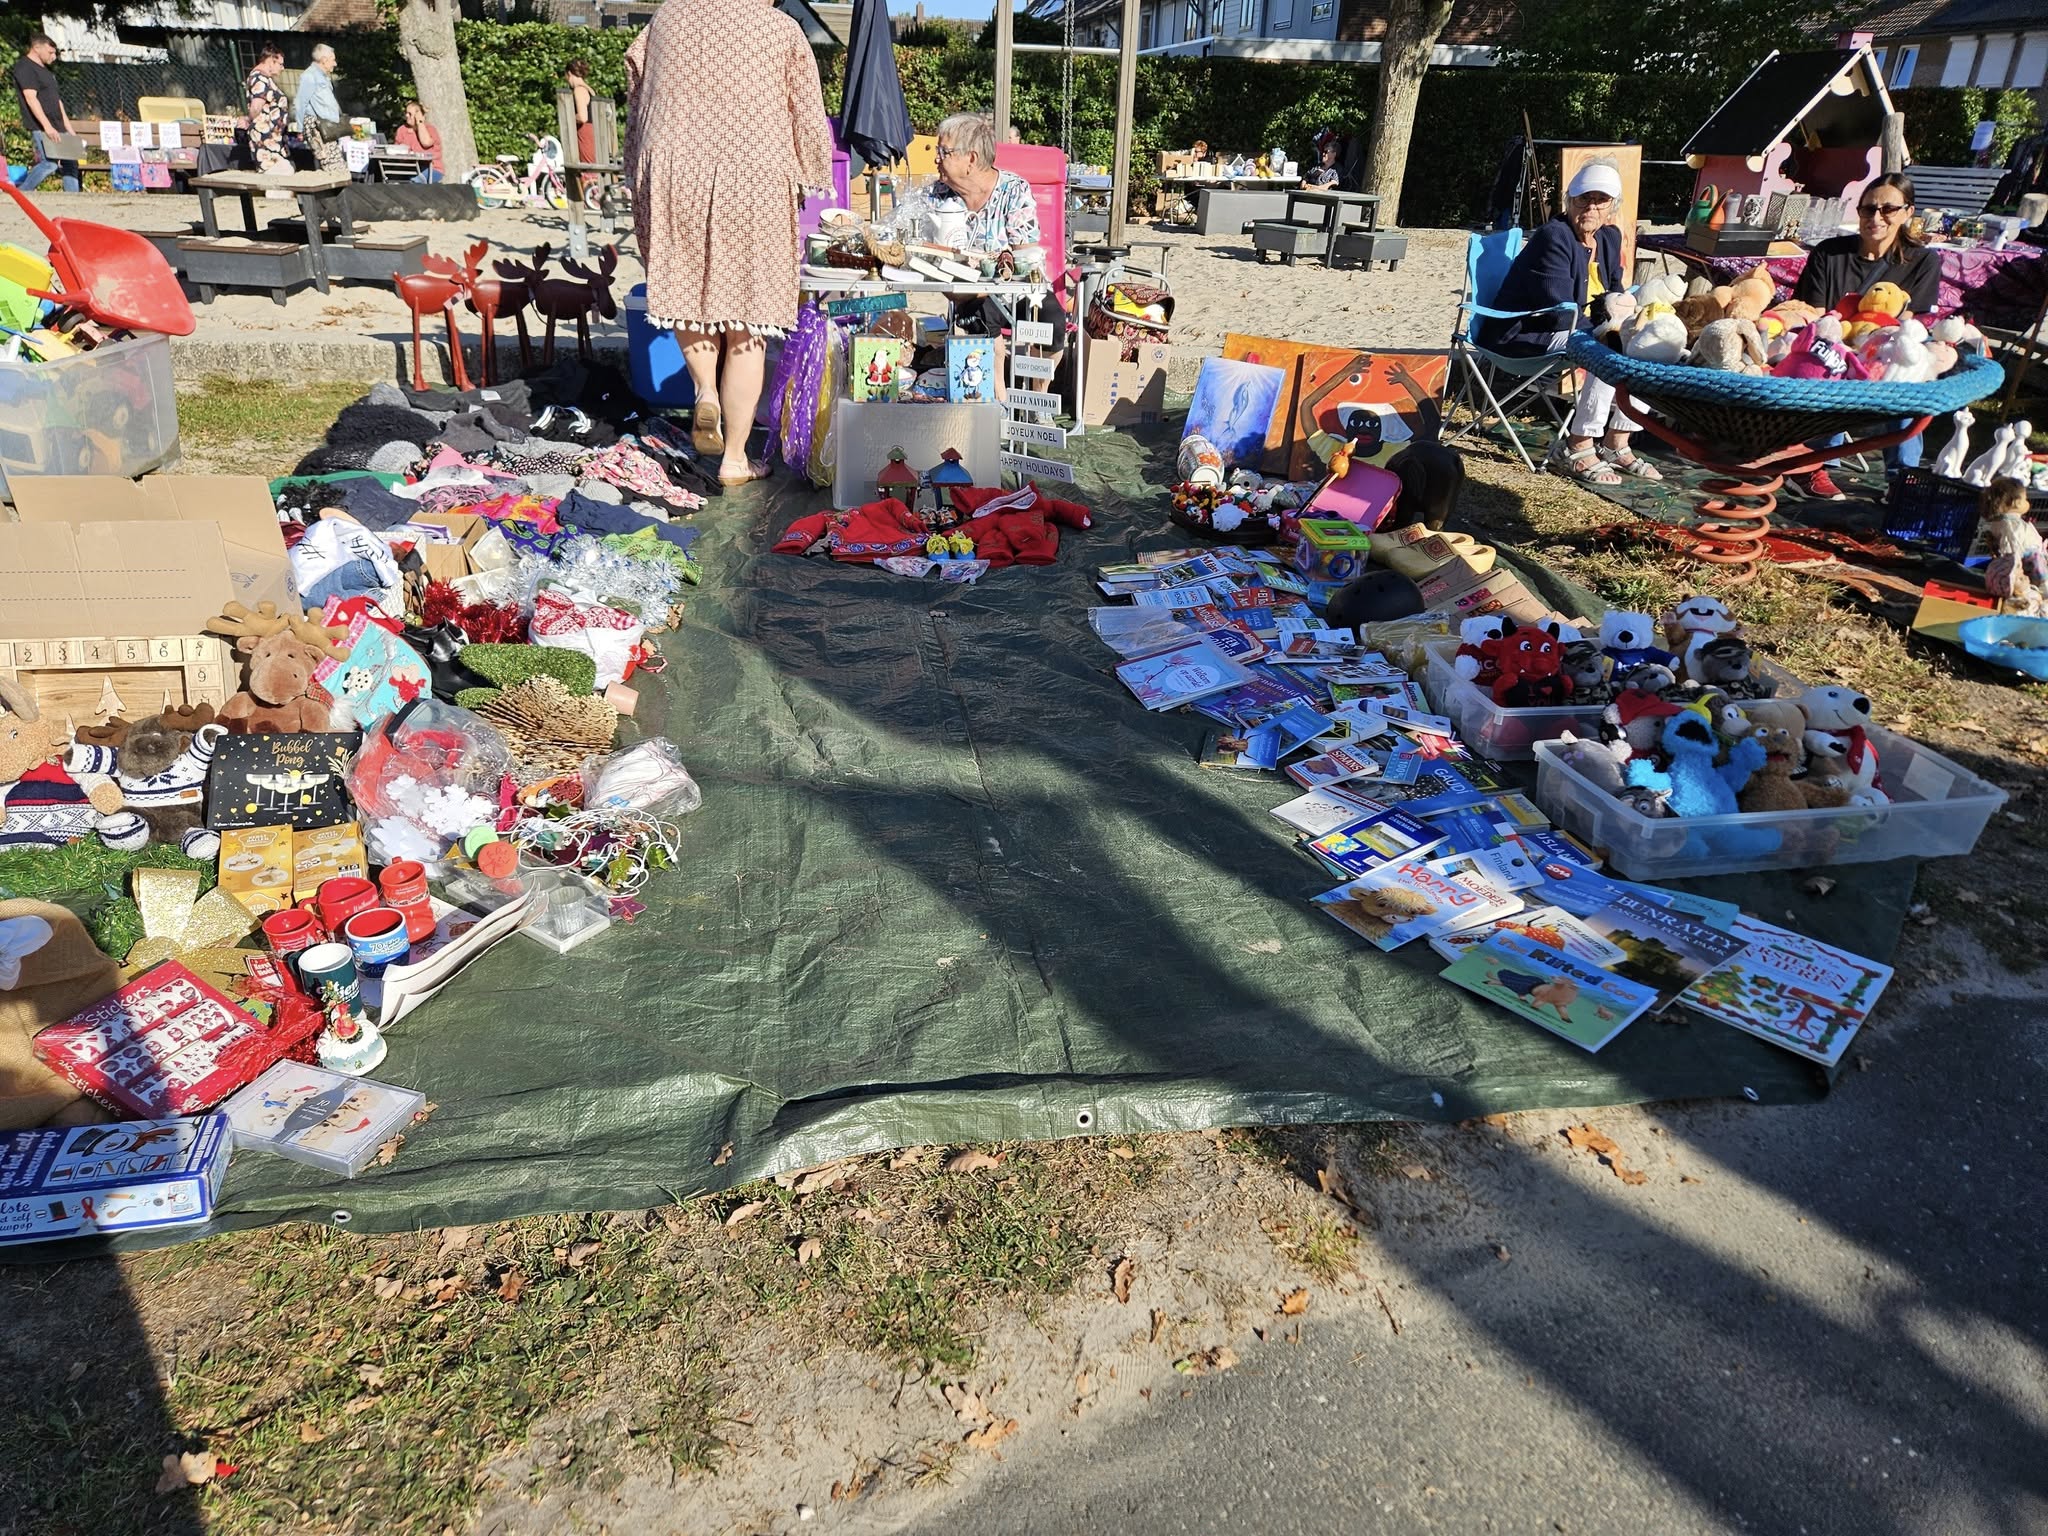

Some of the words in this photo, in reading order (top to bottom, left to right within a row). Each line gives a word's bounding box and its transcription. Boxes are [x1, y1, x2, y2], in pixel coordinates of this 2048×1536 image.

[1019, 327, 1034, 338] GOD
[1035, 328, 1049, 339] JUL
[1016, 362, 1030, 372] MERRY
[1009, 394, 1027, 405] FELIZ
[1029, 396, 1057, 409] NAVIDAD
[1007, 425, 1035, 439] JOYEUX
[1037, 430, 1058, 443] NOEL
[1000, 454, 1023, 470] HAPPY
[1026, 459, 1065, 479] HOLIDAYS
[271, 739, 314, 755] Bubbel
[276, 753, 305, 768] Pong
[1331, 750, 1364, 772] SPAANS
[1490, 852, 1515, 882] Finland
[1397, 863, 1477, 907] Harry
[1458, 876, 1508, 906] MOEDER
[1616, 895, 1739, 950] BUNRATTY
[1693, 938, 1728, 956] PARK
[1528, 949, 1605, 986] Kilted
[1601, 981, 1639, 1001] Coo
[85, 985, 152, 1028] Stickers
[66, 1071, 124, 1118] Stickers
